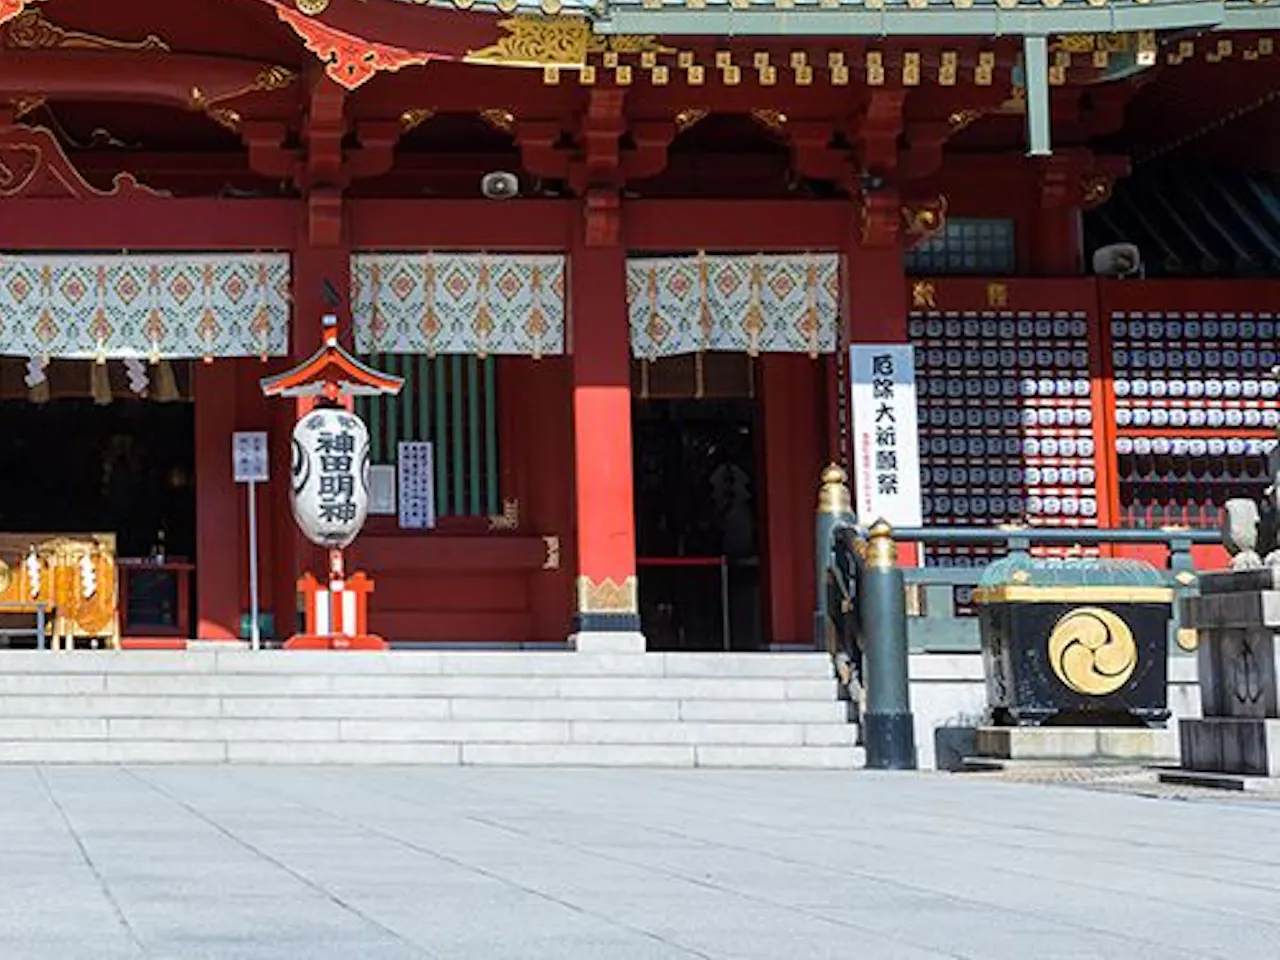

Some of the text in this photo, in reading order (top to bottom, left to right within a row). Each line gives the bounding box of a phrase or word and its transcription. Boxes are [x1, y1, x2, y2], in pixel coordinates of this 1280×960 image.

[315, 431, 355, 524] 神田明神
[873, 355, 898, 494] 厄除大祈願祭
